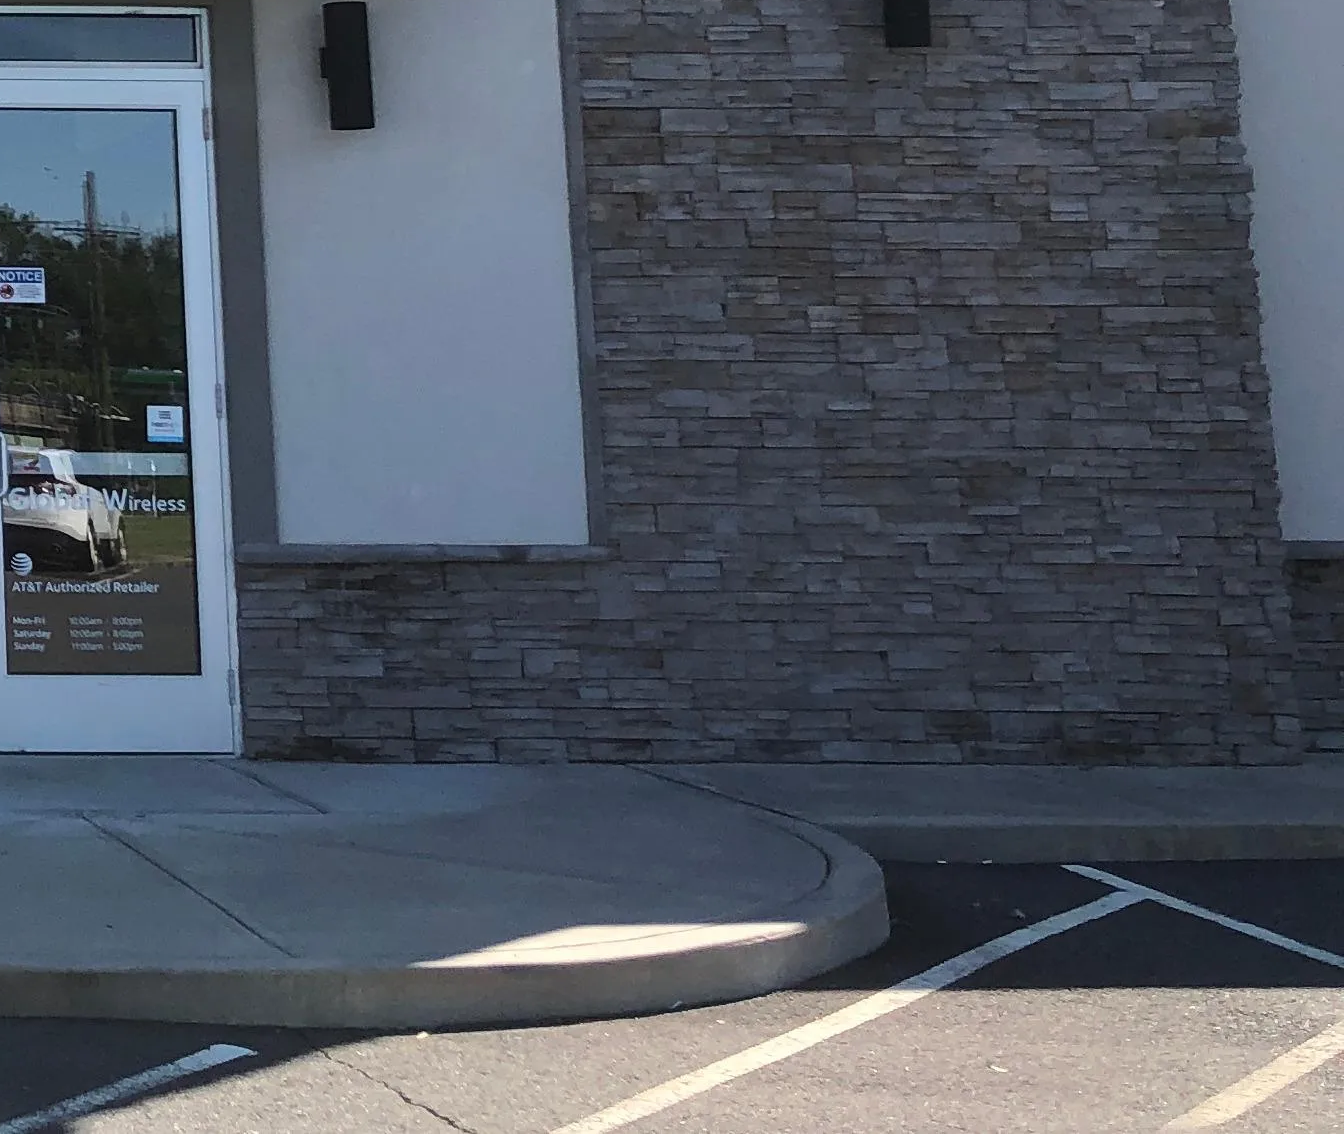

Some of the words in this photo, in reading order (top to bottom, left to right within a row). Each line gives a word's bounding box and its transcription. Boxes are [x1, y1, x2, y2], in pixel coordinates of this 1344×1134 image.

[101, 487, 186, 512] Wireless
[12, 581, 41, 593] AT&T
[45, 580, 110, 593] Authorized
[113, 581, 159, 593] Retailer
[13, 629, 52, 640] Saturday
[13, 641, 45, 652] Sunday
